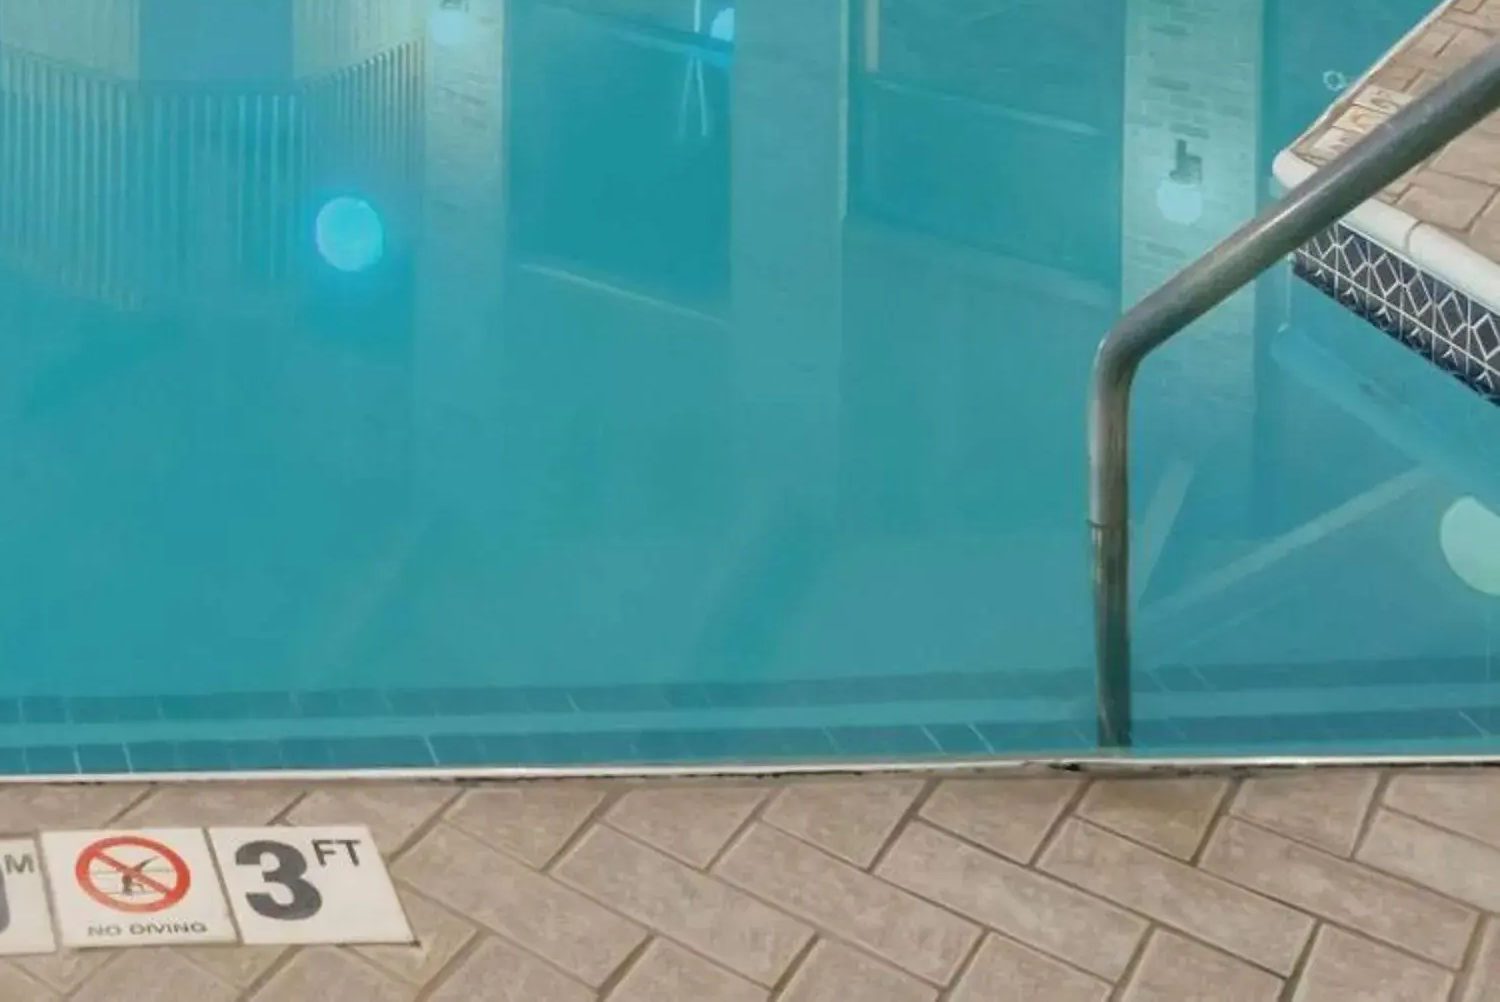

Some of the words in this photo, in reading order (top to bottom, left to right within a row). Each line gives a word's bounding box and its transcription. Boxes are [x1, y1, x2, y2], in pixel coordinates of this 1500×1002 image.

[235, 839, 323, 921] 3
[311, 839, 362, 867] FT
[86, 924, 122, 938] NO
[129, 921, 208, 936] DIVING
